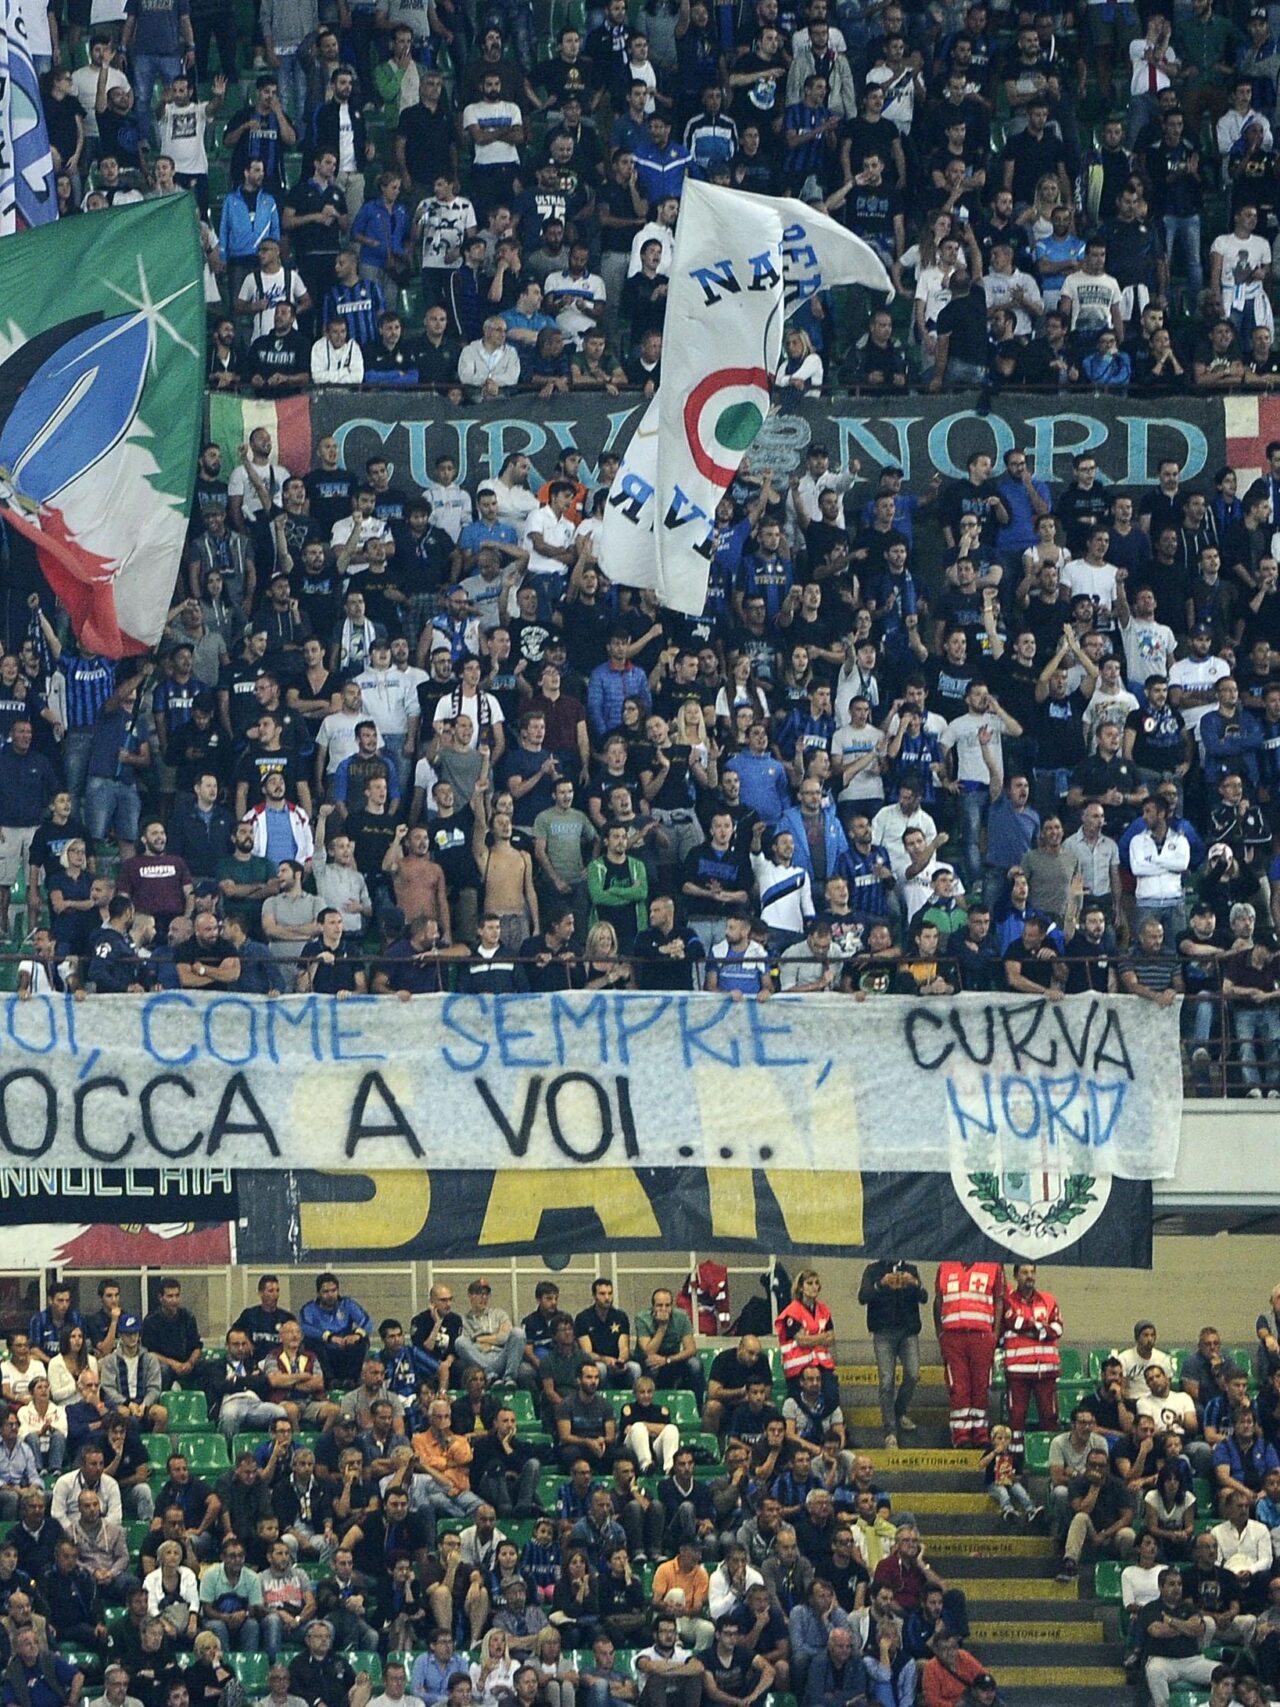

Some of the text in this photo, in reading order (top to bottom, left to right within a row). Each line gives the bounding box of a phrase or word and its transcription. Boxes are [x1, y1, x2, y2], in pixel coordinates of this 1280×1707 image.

[827, 409, 1209, 487] NORD
[141, 992, 386, 1066] COME
[903, 1000, 1136, 1082] CURVA
[345, 1069, 426, 1159] A
[947, 1070, 1128, 1147] NORD
